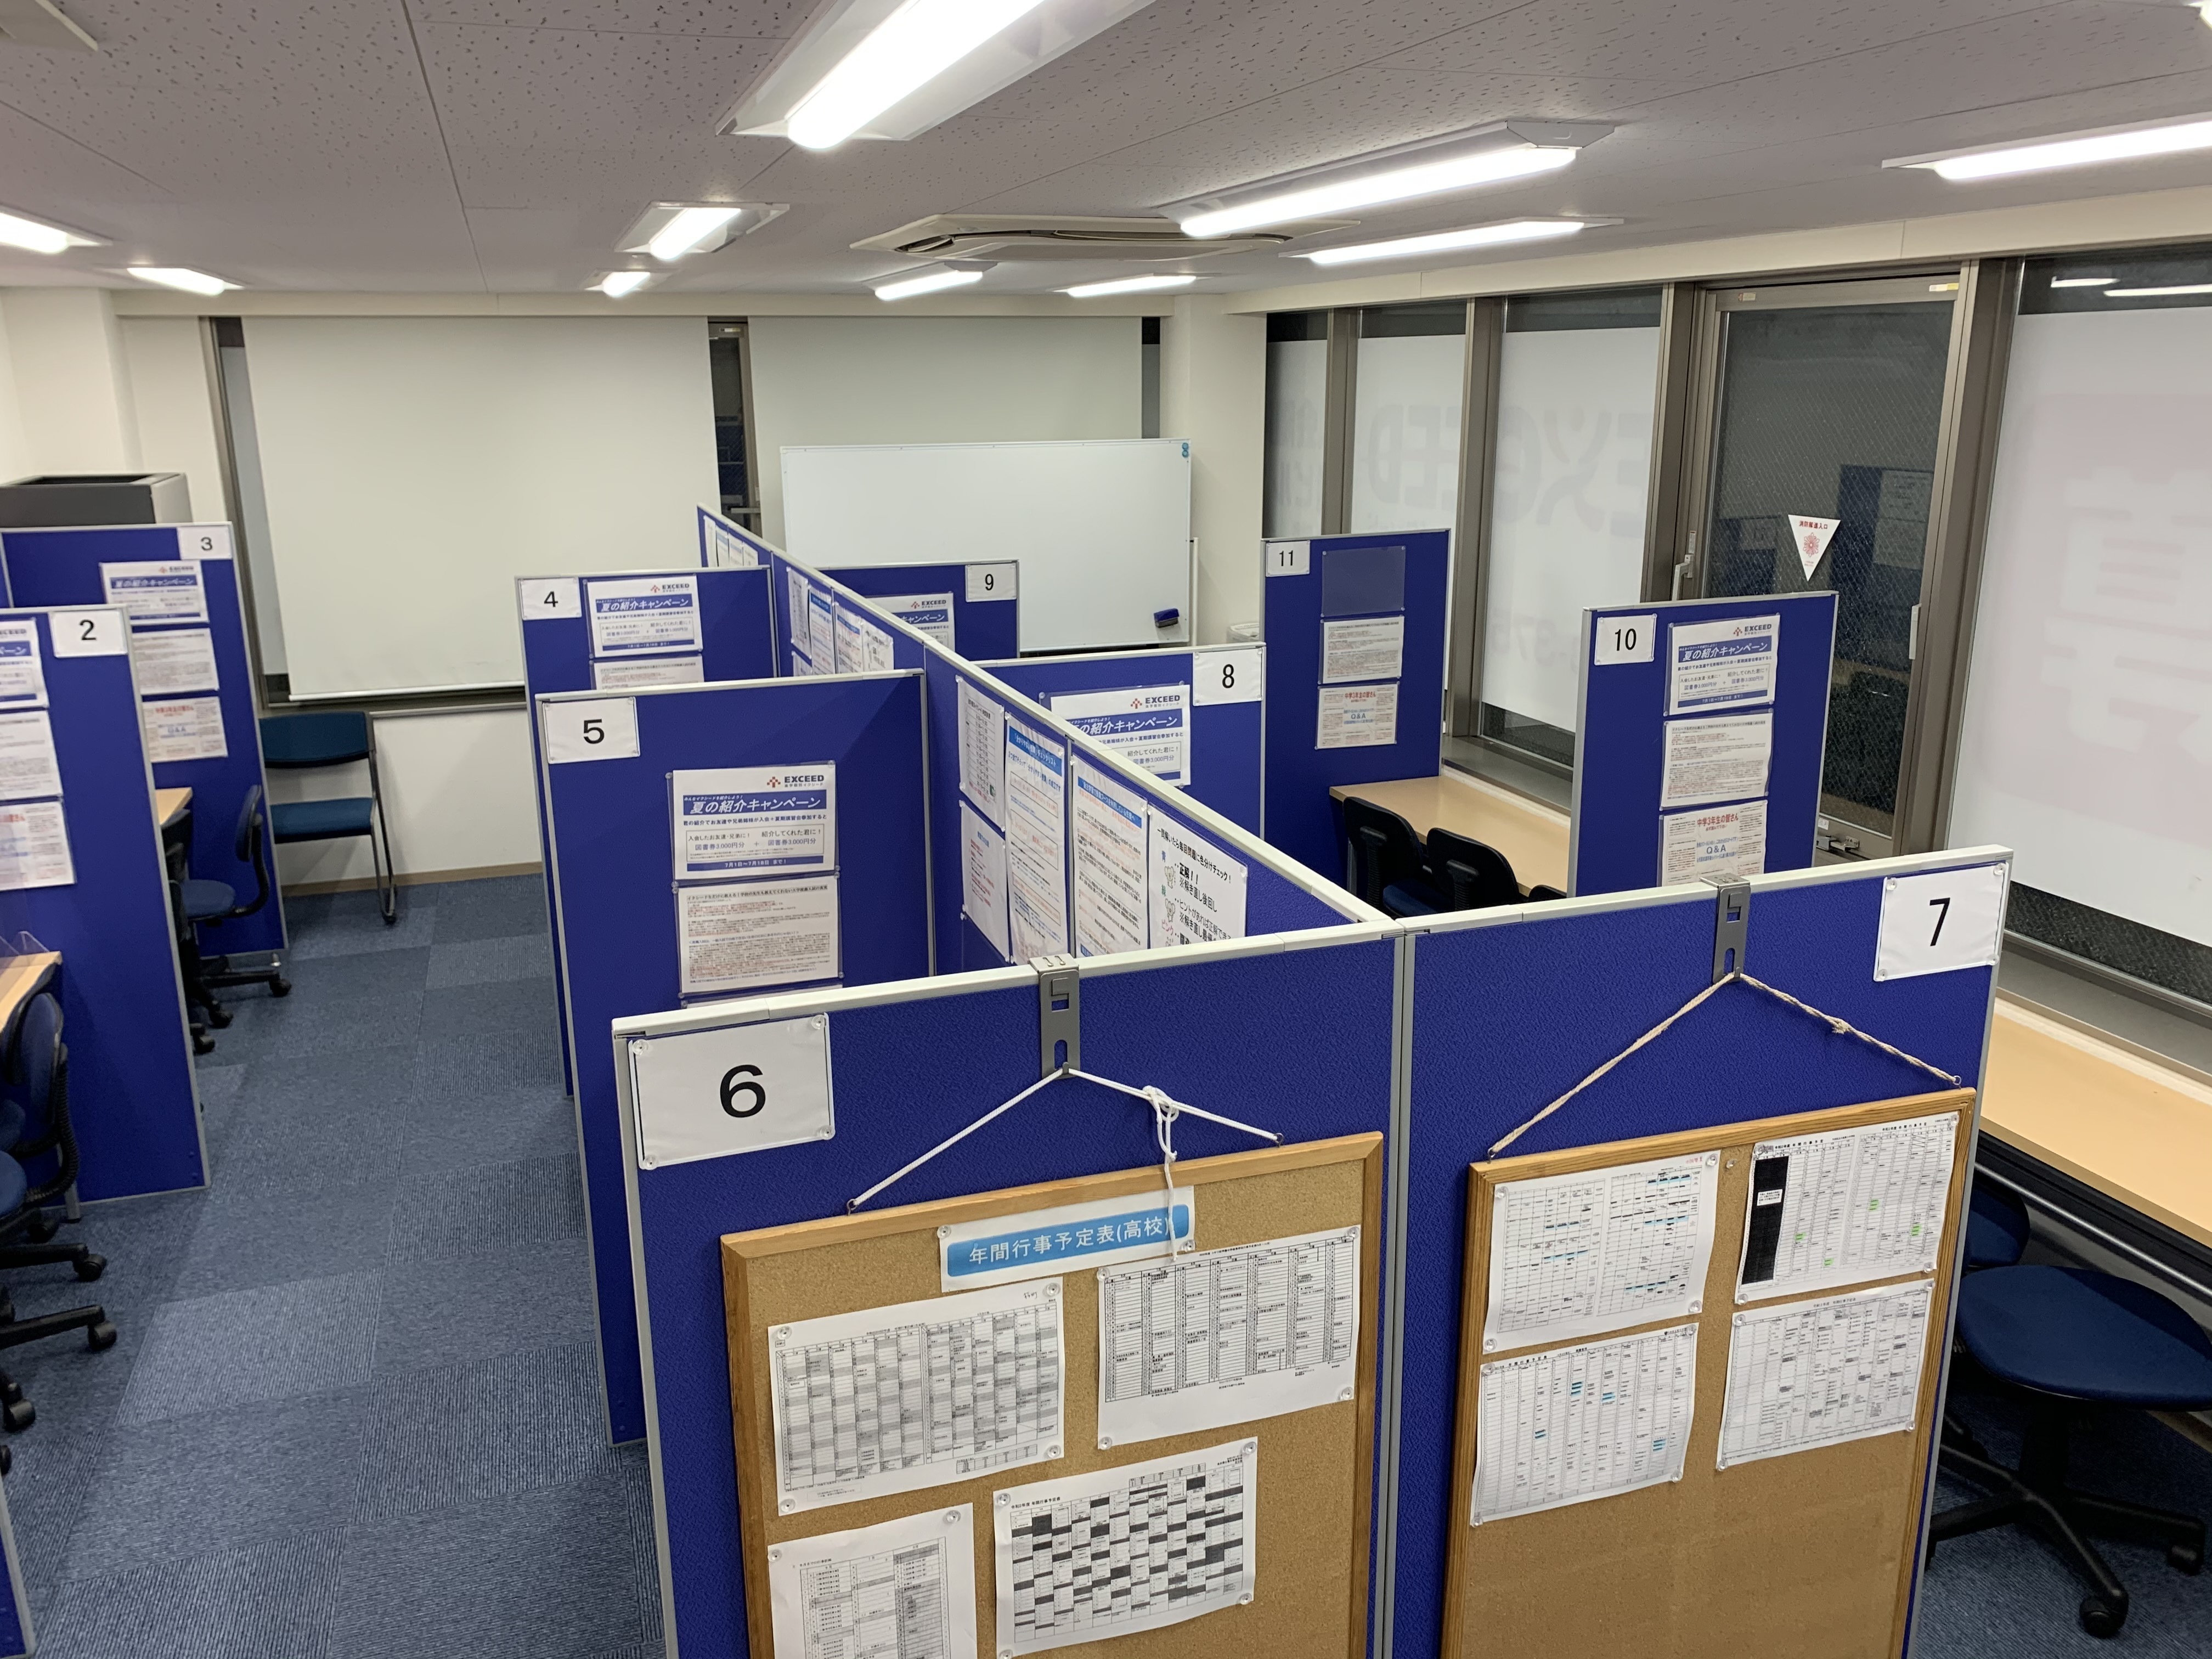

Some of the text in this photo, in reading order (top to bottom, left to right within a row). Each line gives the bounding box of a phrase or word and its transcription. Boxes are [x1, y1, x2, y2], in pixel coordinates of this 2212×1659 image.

[1799, 520, 1828, 529] 消防隊進入口
[201, 537, 212, 551] 3
[1279, 550, 1293, 566] 11
[985, 574, 994, 591] 9
[544, 591, 558, 607] 4
[80, 619, 97, 640] 2
[1614, 628, 1637, 651] 10
[1683, 642, 1768, 661] 夏の紹介キャンペーン
[1222, 664, 1234, 689] 8
[1145, 695, 1180, 704] EXCEED
[583, 719, 605, 744] 5
[1073, 717, 1177, 735] の紹介キャンペーン
[785, 775, 824, 783] EXCEED
[690, 797, 821, 814] 夏の紹介キャンペーン
[1929, 897, 1950, 946] 7
[720, 1064, 766, 1118] 6
